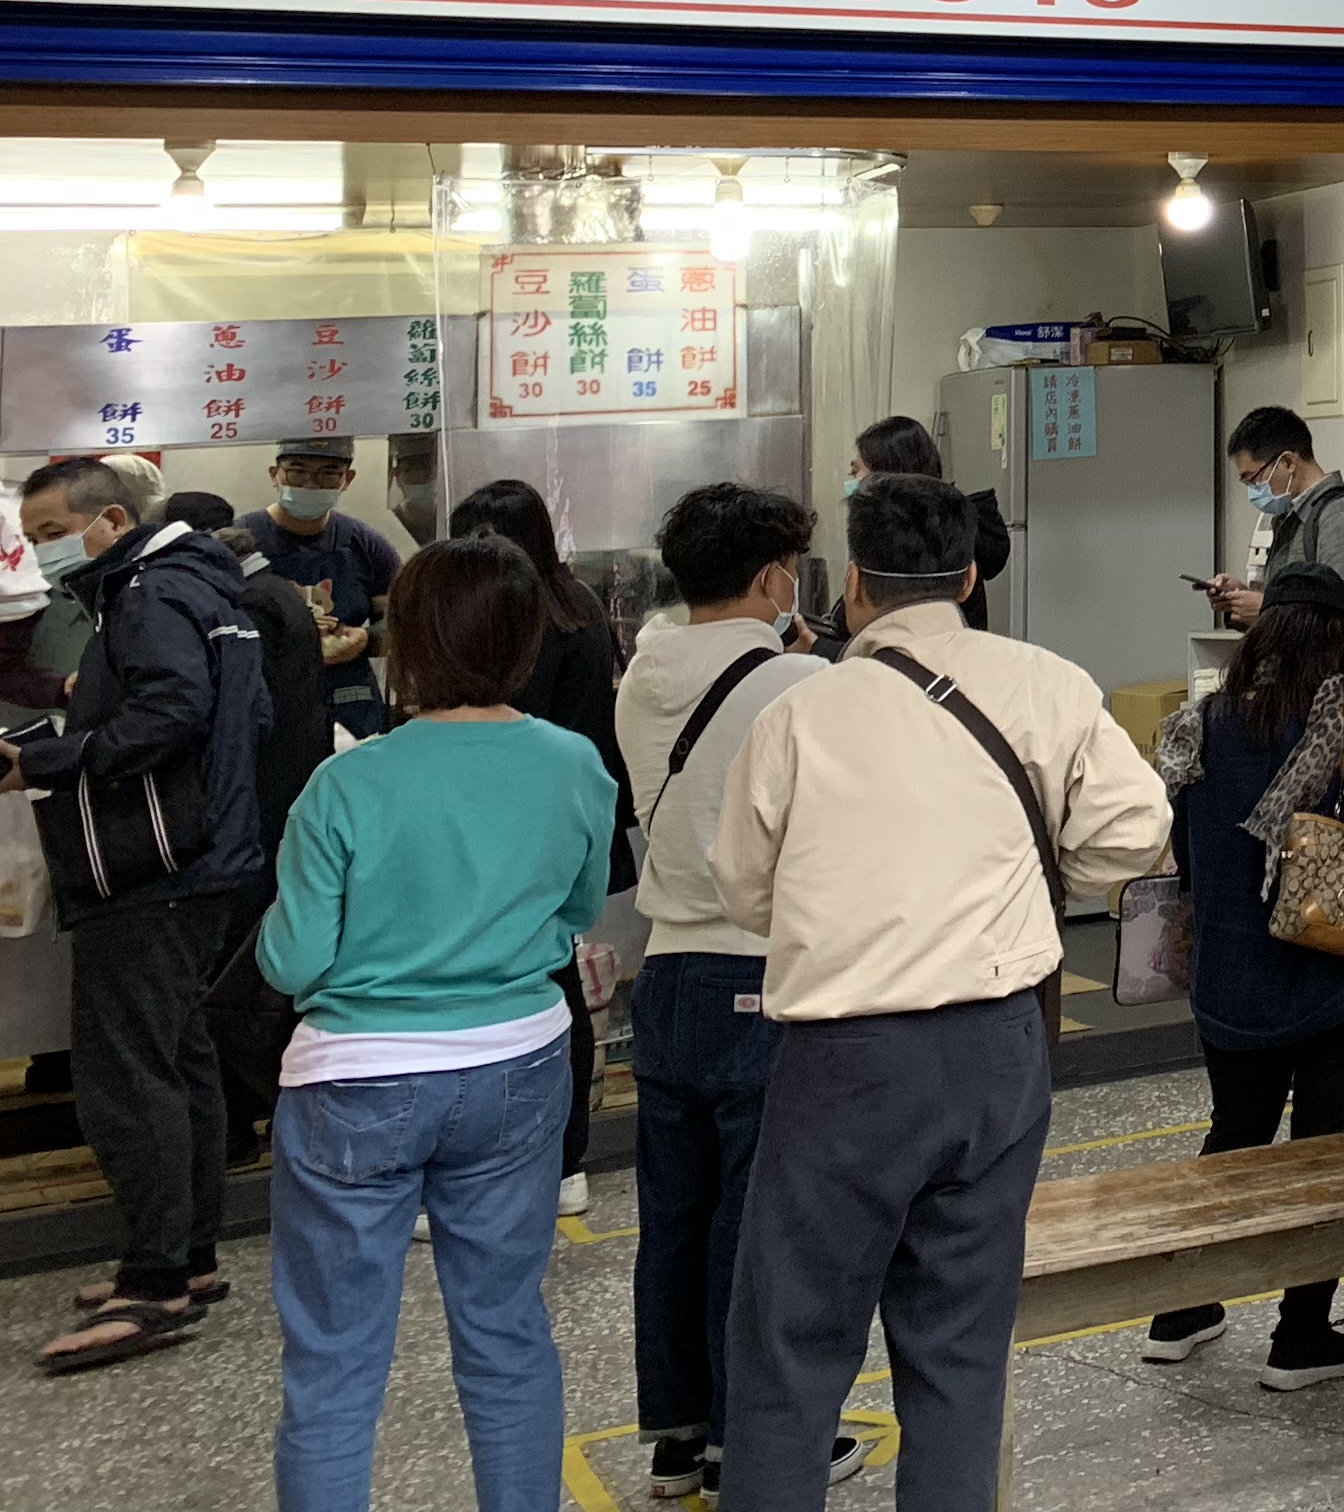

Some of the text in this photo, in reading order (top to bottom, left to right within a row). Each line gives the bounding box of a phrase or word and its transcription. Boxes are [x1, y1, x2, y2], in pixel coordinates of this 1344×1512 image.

[510, 268, 552, 378] 豆沙餅
[678, 266, 719, 372] 蔥油餅
[98, 327, 144, 425] 蛋餅
[202, 325, 248, 421] 蔥油餅
[304, 323, 348, 416] 豆沙餅
[518, 382, 544, 400] 30
[576, 379, 602, 396] 30
[632, 380, 658, 398] 35
[687, 380, 712, 397] 25
[210, 421, 239, 440] 25
[311, 416, 338, 434] 30
[409, 412, 435, 430] 30
[105, 426, 136, 445] 35
